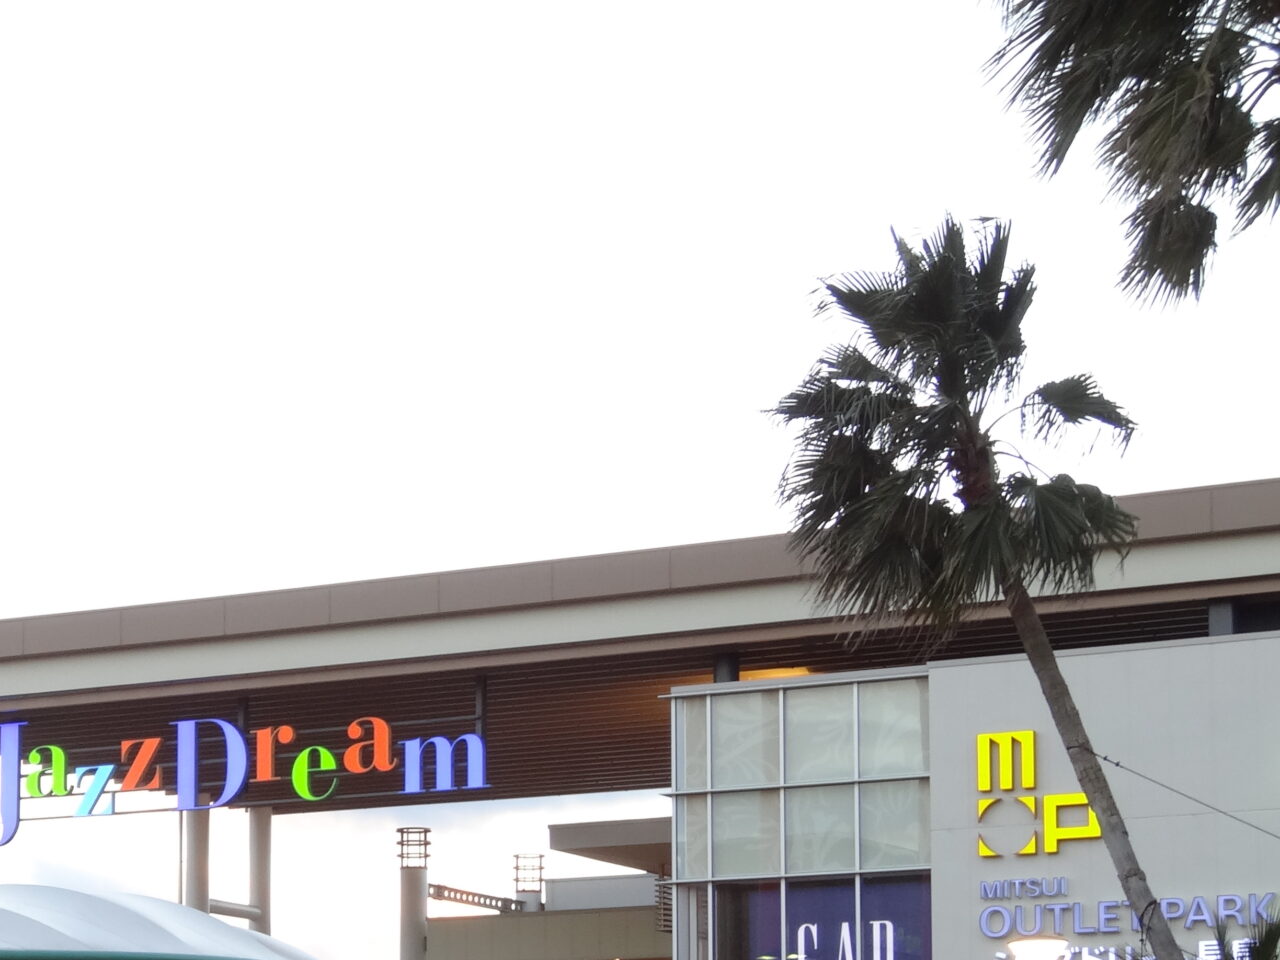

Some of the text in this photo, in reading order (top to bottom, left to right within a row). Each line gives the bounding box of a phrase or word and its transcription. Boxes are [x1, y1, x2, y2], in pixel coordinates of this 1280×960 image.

[979, 876, 1067, 900] MITSUI
[978, 893, 1276, 939] OUTLET PARK
